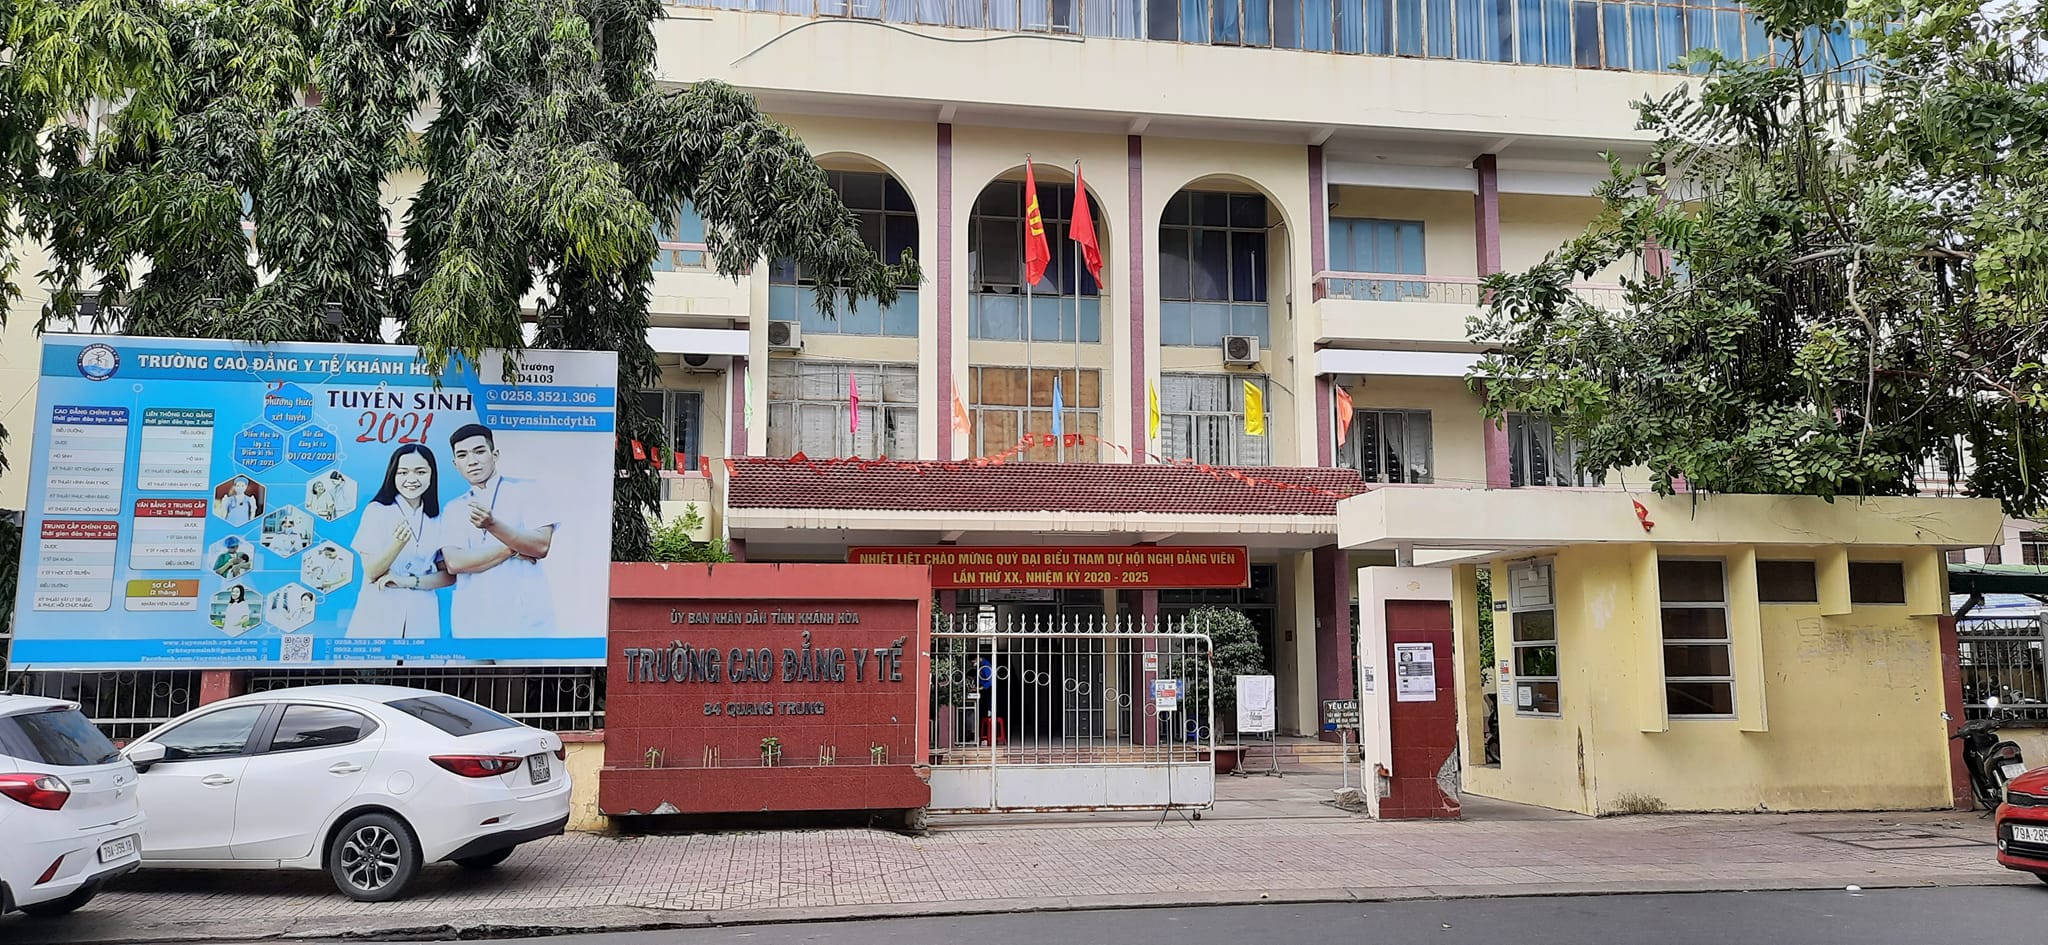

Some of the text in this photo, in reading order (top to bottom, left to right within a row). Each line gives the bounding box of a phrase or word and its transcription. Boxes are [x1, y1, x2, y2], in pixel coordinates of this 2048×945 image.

[138, 352, 208, 369] TRƯỜNG
[214, 356, 248, 370] CAO
[253, 352, 297, 371] ĐẲNG
[303, 359, 314, 372] Y
[319, 353, 340, 372] TẾ
[346, 358, 404, 375] KHÁNH
[501, 374, 553, 384] CD4103
[328, 381, 472, 410] TUYỂN SINH
[501, 390, 596, 403] 0258.3521.306
[356, 411, 433, 444] 2021
[500, 415, 596, 428] tuyensinhcdytkh
[288, 452, 336, 461] 01/02/2021
[924, 552, 955, 565] CHÀO
[959, 552, 993, 565] MỪNG
[1022, 554, 1040, 567] ĐẠI
[1044, 550, 1070, 565] BIỂU
[1073, 553, 1104, 565] THAM
[1108, 553, 1123, 567] DỰ
[1126, 552, 1144, 567] HỘI
[1148, 553, 1174, 567] NGHỊ
[1177, 550, 1207, 565] ĐẢNG
[1210, 551, 1235, 565] VIÊN
[979, 569, 1001, 583] THỨ
[1004, 572, 1022, 584] XX,
[1026, 570, 1063, 585] NHIỆM
[1084, 572, 1111, 583] 2020
[1122, 572, 1149, 583] 2025
[670, 608, 860, 624] ỦY BAN NHÂN DÂN TỈNH KHÁNH HÒA
[624, 630, 907, 683] TRƯỜNG CAO ĐẲNG Y TẾ
[703, 701, 825, 717] 84 QUANG TRUNG
